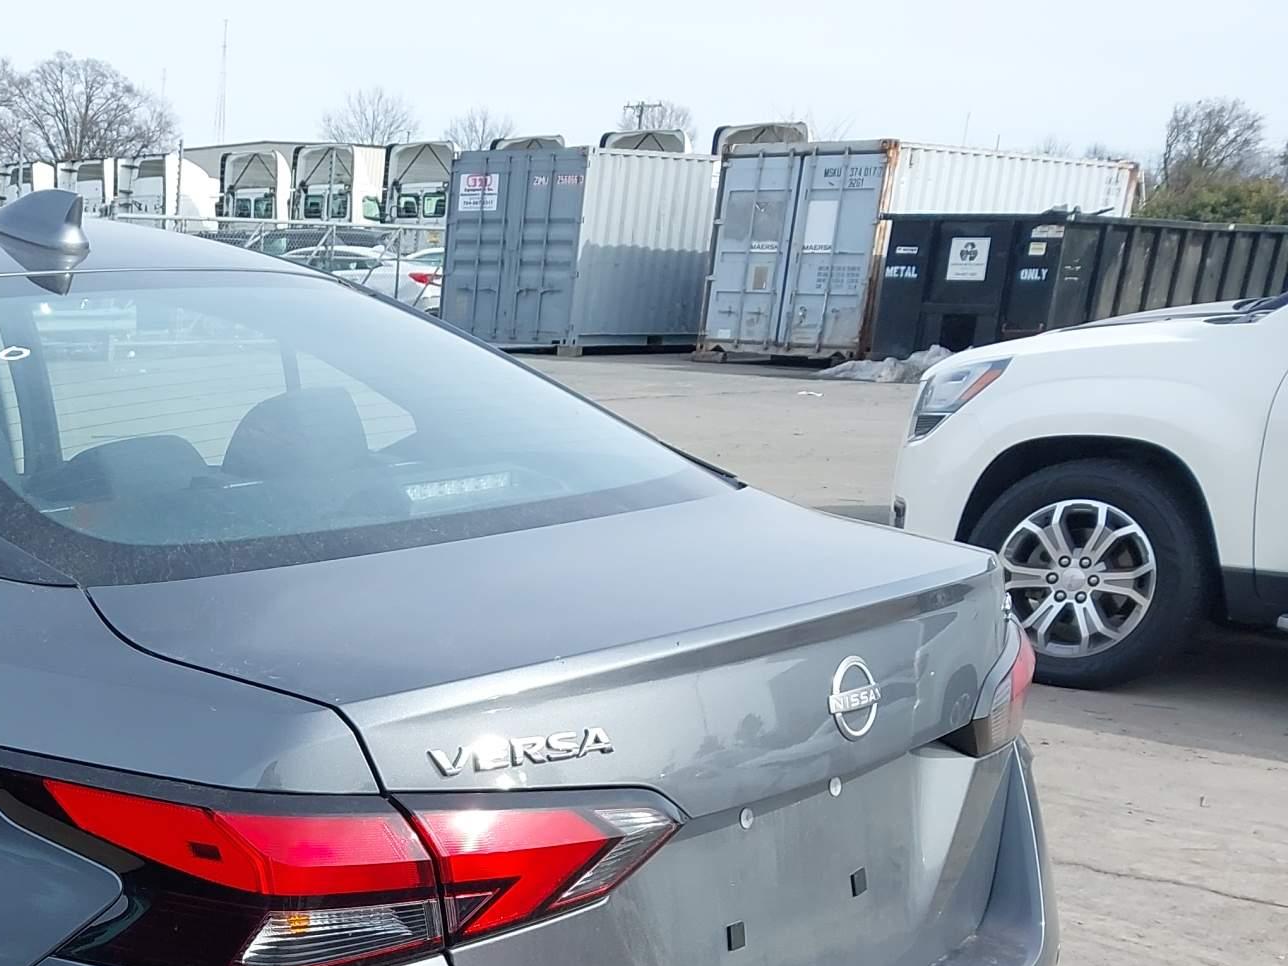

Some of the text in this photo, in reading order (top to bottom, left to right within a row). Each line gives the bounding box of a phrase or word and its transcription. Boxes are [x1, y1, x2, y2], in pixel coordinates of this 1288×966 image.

[824, 167, 842, 177] MSKU
[885, 266, 918, 278] METAL
[1020, 268, 1049, 280] ONLY
[426, 726, 614, 778] VERSA
